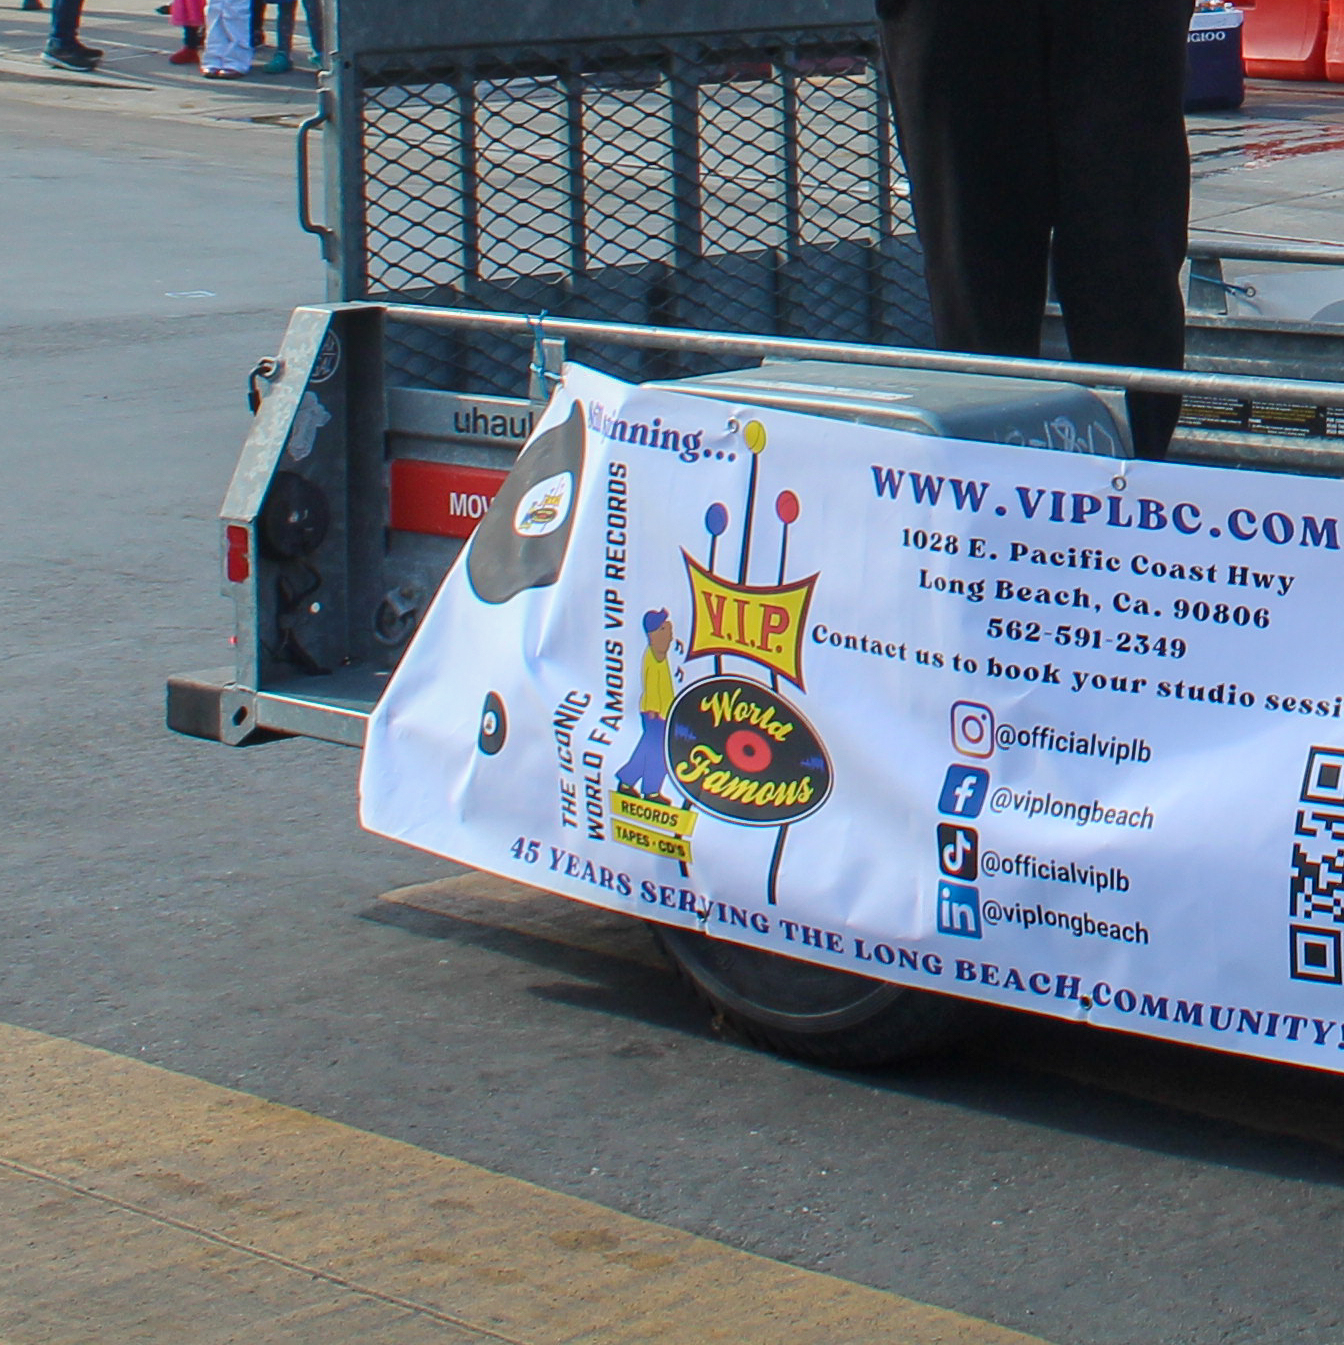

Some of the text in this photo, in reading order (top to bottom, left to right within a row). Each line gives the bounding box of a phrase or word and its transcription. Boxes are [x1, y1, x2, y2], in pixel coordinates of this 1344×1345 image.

[871, 465, 1340, 550] WWW.VIPLBC.COM
[902, 528, 1296, 597] 1028 E. Pacific Coast Hwy
[702, 590, 790, 653] V.I.P.
[919, 569, 1271, 629] Long Beach, Ca. 90806
[582, 461, 628, 841] WORLD FAMOUS VIP RECORDS
[811, 623, 908, 661] Contact
[916, 648, 945, 669] us
[953, 653, 979, 674] to
[987, 657, 1062, 685] book
[1072, 670, 1148, 694] your
[1156, 678, 1256, 708] studio
[987, 618, 1188, 659] 562-591-2349
[700, 687, 794, 742] World
[995, 723, 1152, 766] @officialviplb
[552, 689, 592, 830] THE ICONIC
[675, 744, 814, 807] Famous
[615, 825, 650, 848] TAPES
[621, 799, 679, 828] RECORDS
[989, 786, 1155, 830] @viplongbeach
[980, 850, 1130, 893] @officialviplb
[510, 835, 541, 864] 45
[548, 845, 633, 897] YEARS
[640, 879, 771, 935] SERVING
[780, 918, 845, 955] THE
[854, 937, 944, 976] LONG
[955, 958, 1083, 1001] BEACH
[982, 899, 1150, 945] @viplongbeach
